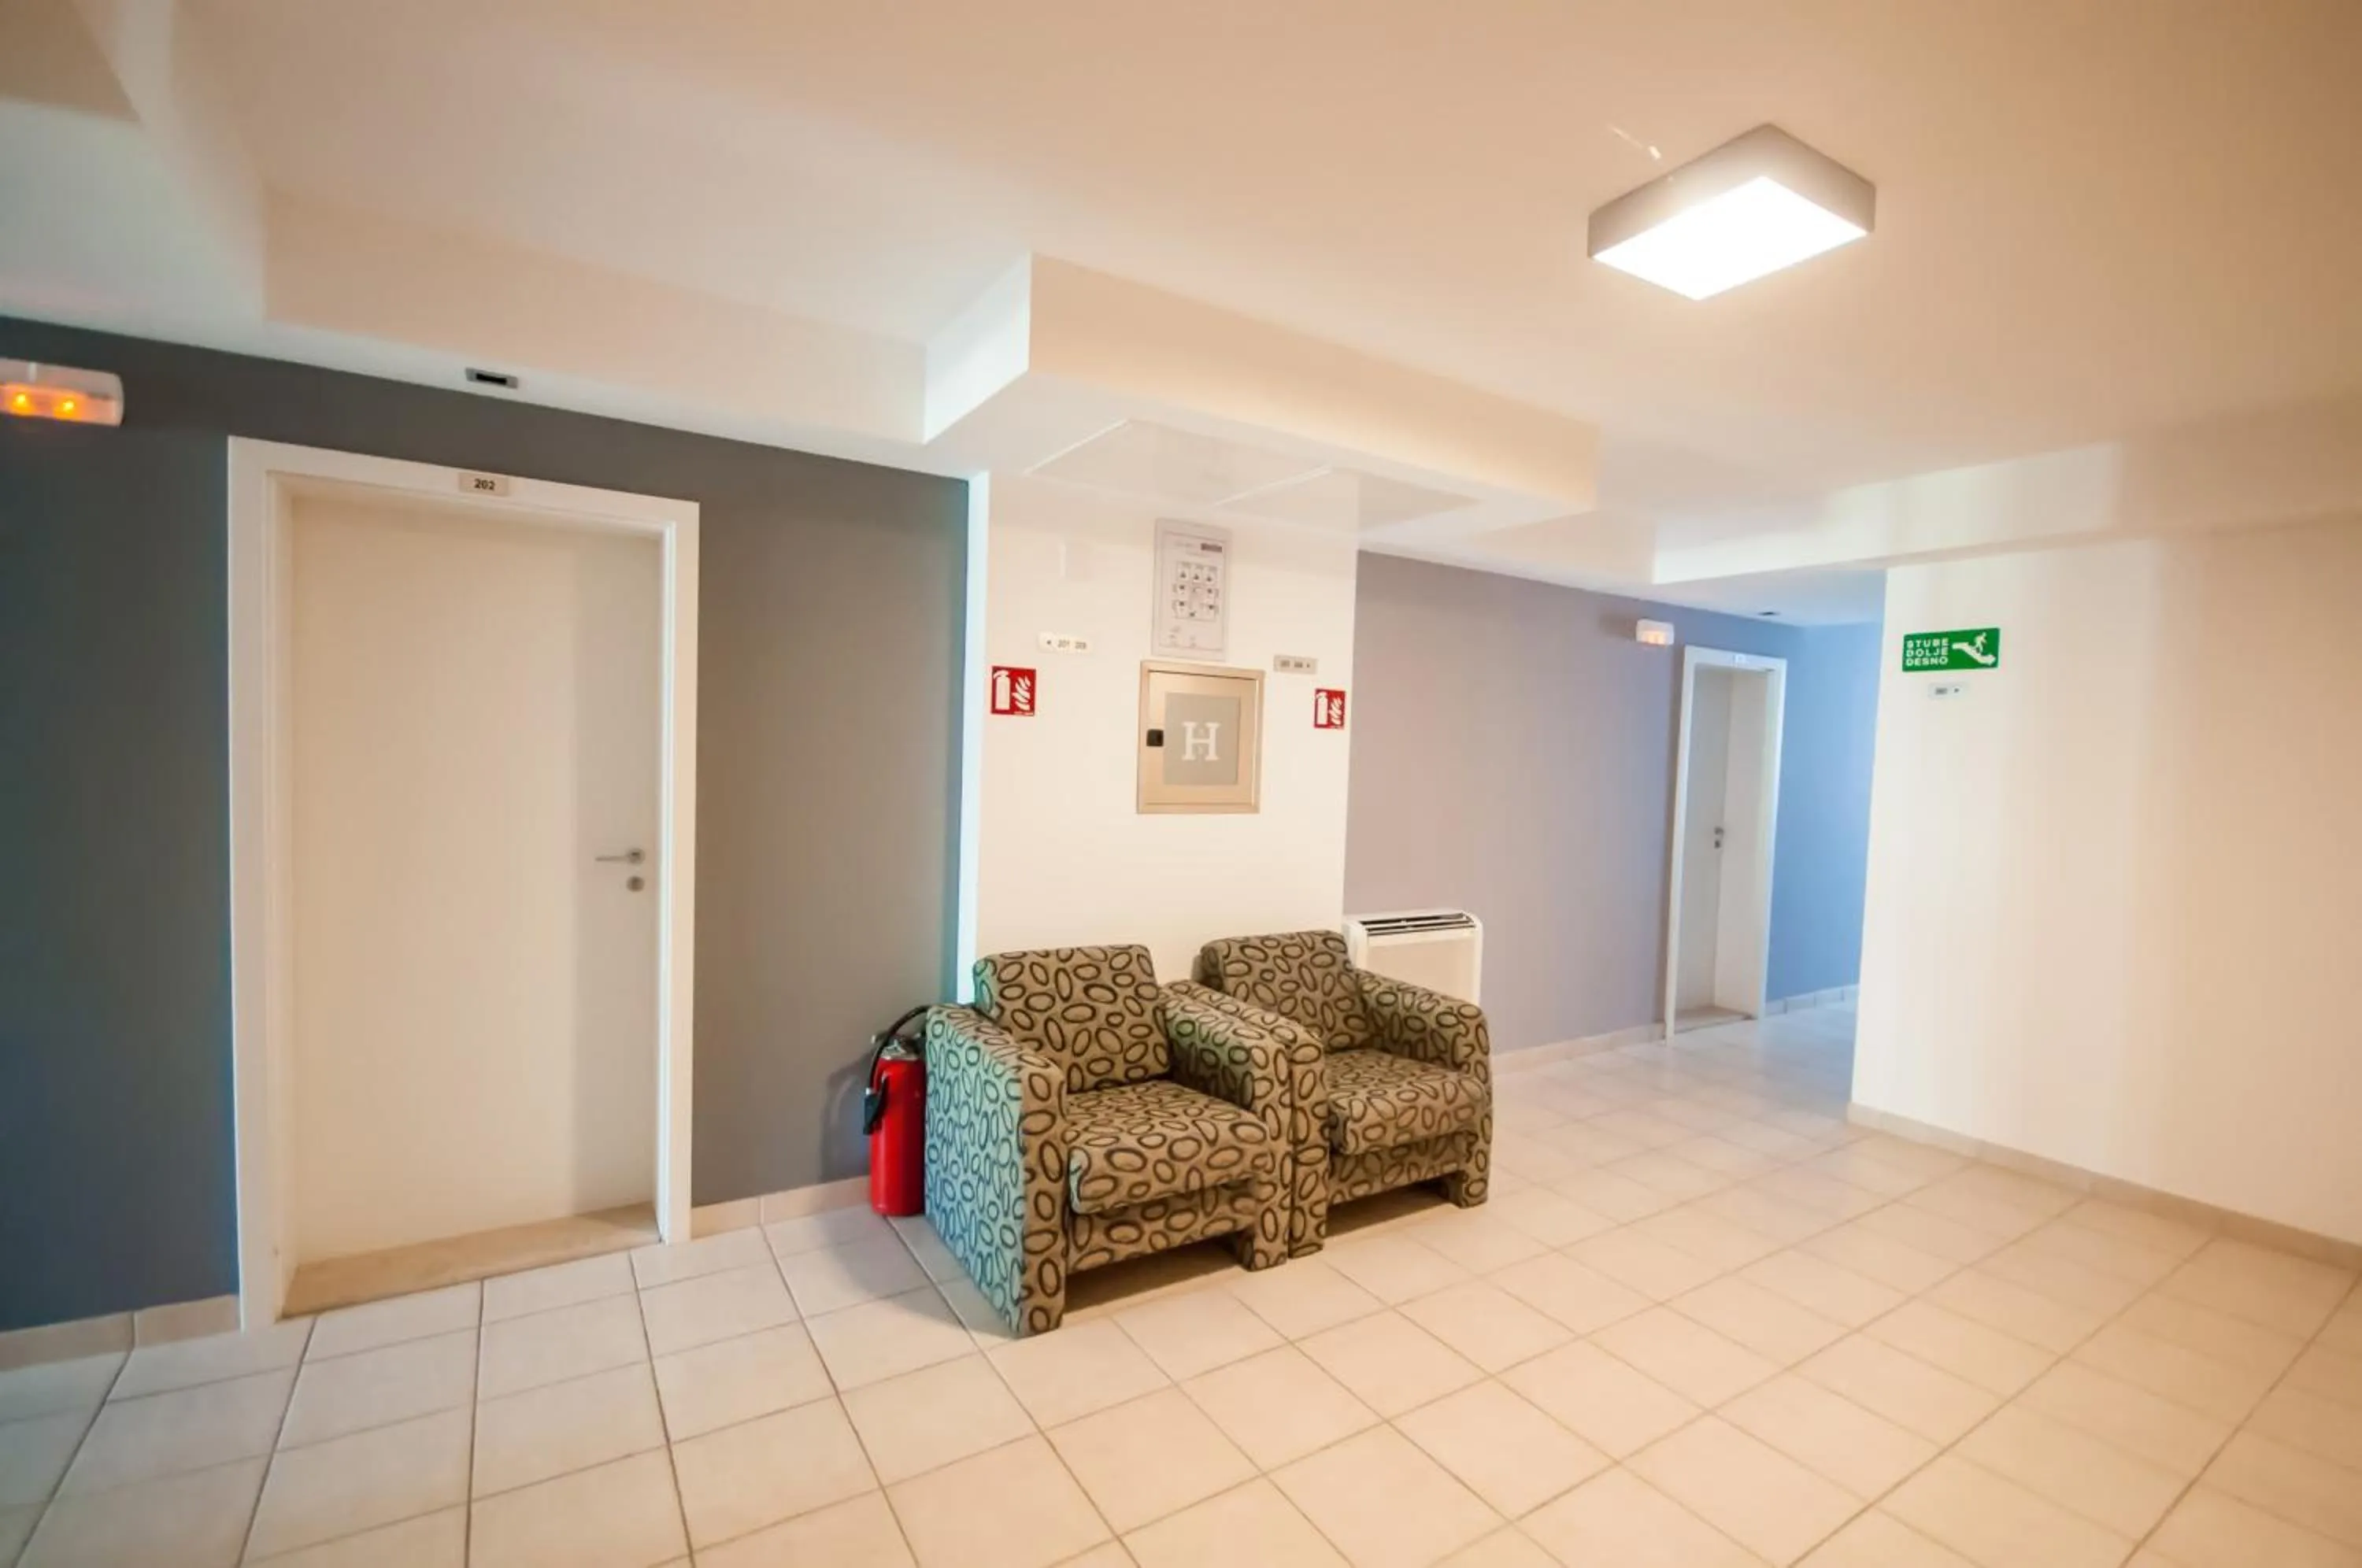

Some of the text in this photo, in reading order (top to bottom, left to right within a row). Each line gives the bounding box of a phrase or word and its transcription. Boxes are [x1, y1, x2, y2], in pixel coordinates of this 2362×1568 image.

[474, 478, 495, 491] 202
[1906, 638, 1949, 649] STUBE
[1905, 647, 1949, 658] DOLJE
[1905, 656, 1949, 666] DESNO
[1182, 721, 1221, 761] H
